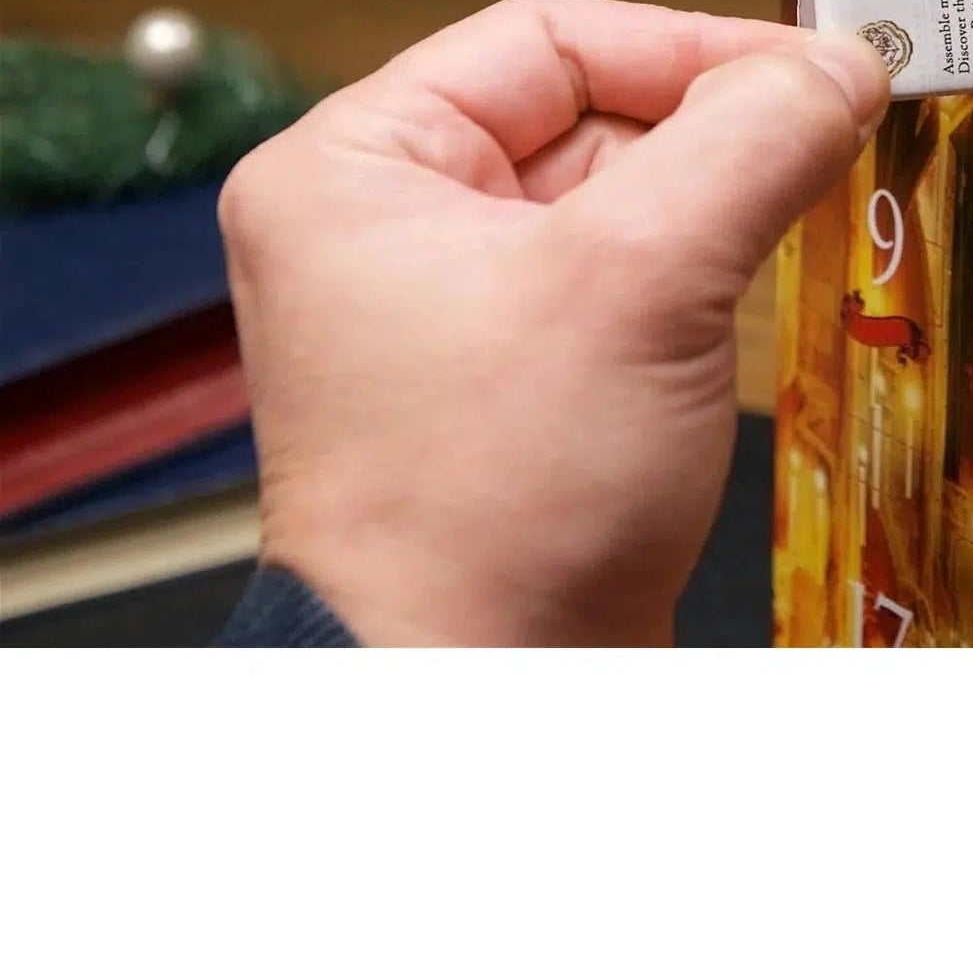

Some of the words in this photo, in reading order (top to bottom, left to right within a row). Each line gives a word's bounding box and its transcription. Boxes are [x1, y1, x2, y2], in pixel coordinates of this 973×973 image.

[938, 10, 955, 74] Assemble
[955, 17, 970, 74] Discover
[866, 187, 904, 286] 9
